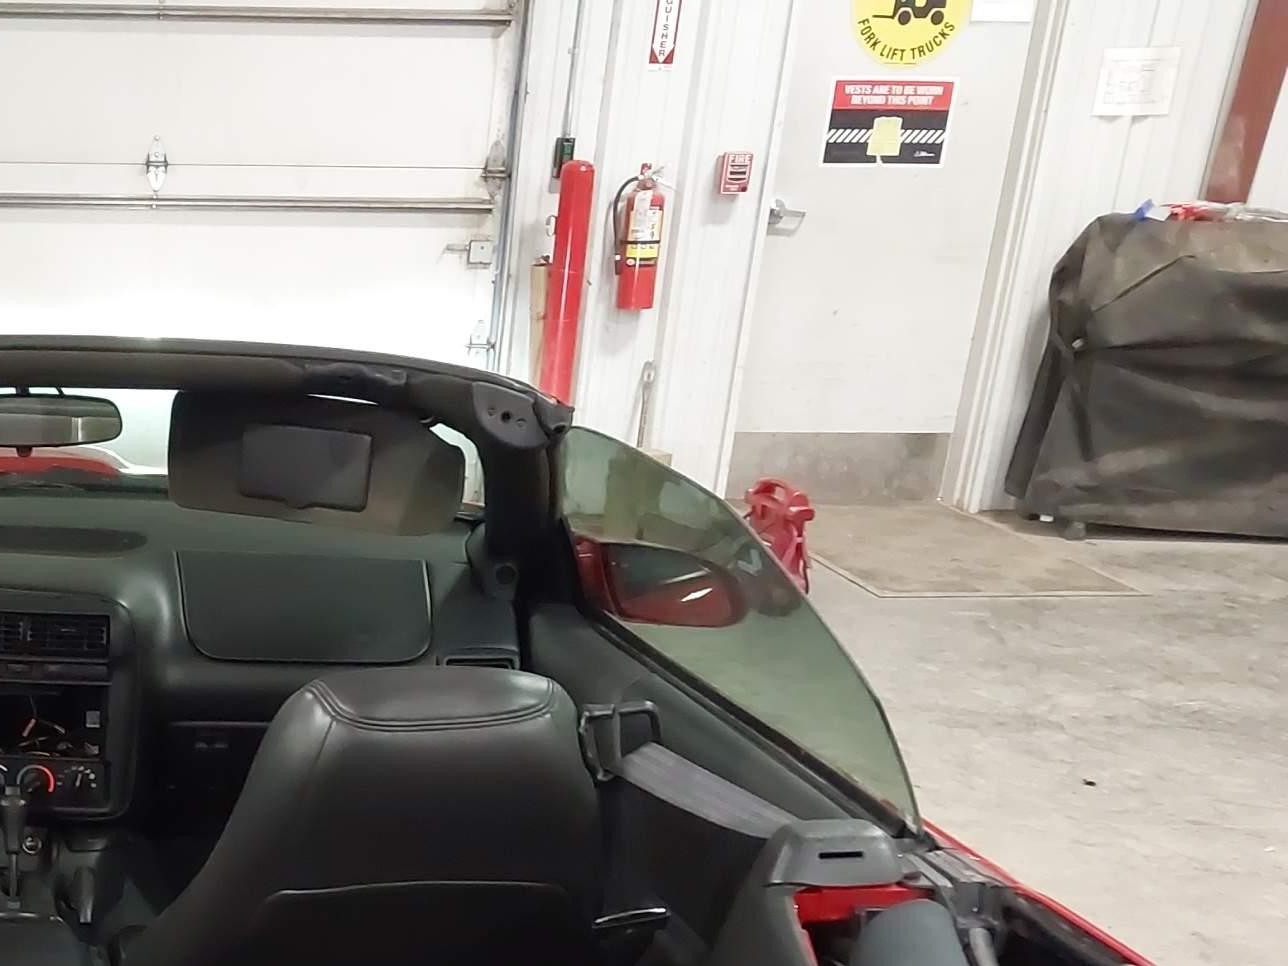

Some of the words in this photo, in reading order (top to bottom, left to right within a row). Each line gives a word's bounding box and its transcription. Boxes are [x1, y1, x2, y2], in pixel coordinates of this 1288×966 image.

[857, 18, 881, 51] FORK
[879, 44, 906, 61] LIFT
[910, 21, 955, 60] TRUCKS
[845, 84, 873, 95] VESTS
[872, 84, 890, 95] ARE
[891, 85, 903, 95] TO
[903, 85, 916, 96] BE
[850, 95, 886, 105] BEYOND
[887, 95, 907, 105] THIS
[907, 96, 935, 106] POINT
[728, 154, 752, 163] FIRE
